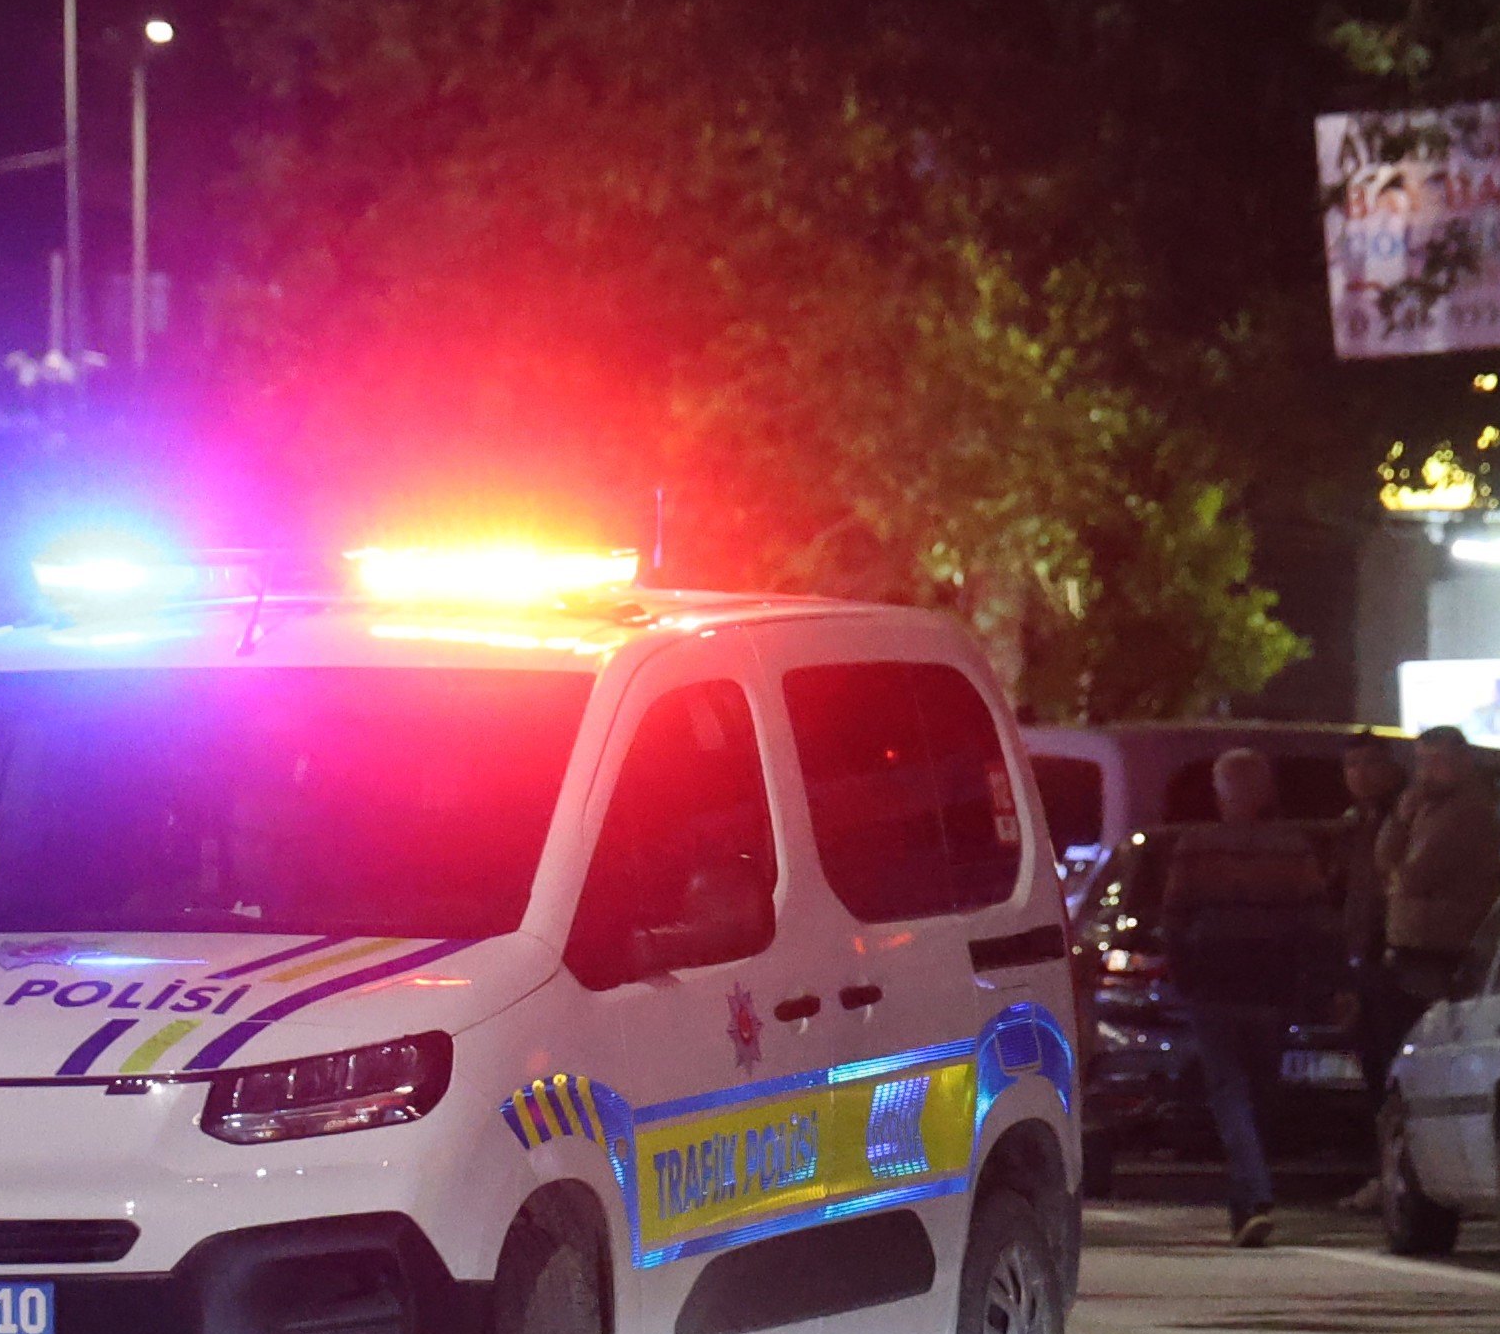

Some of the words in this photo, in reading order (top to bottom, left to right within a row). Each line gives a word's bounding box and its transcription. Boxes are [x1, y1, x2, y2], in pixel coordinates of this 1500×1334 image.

[4, 978, 252, 1016] POLİSİ
[653, 1132, 740, 1221] TRAFİK
[743, 1109, 819, 1196] POLİSİ
